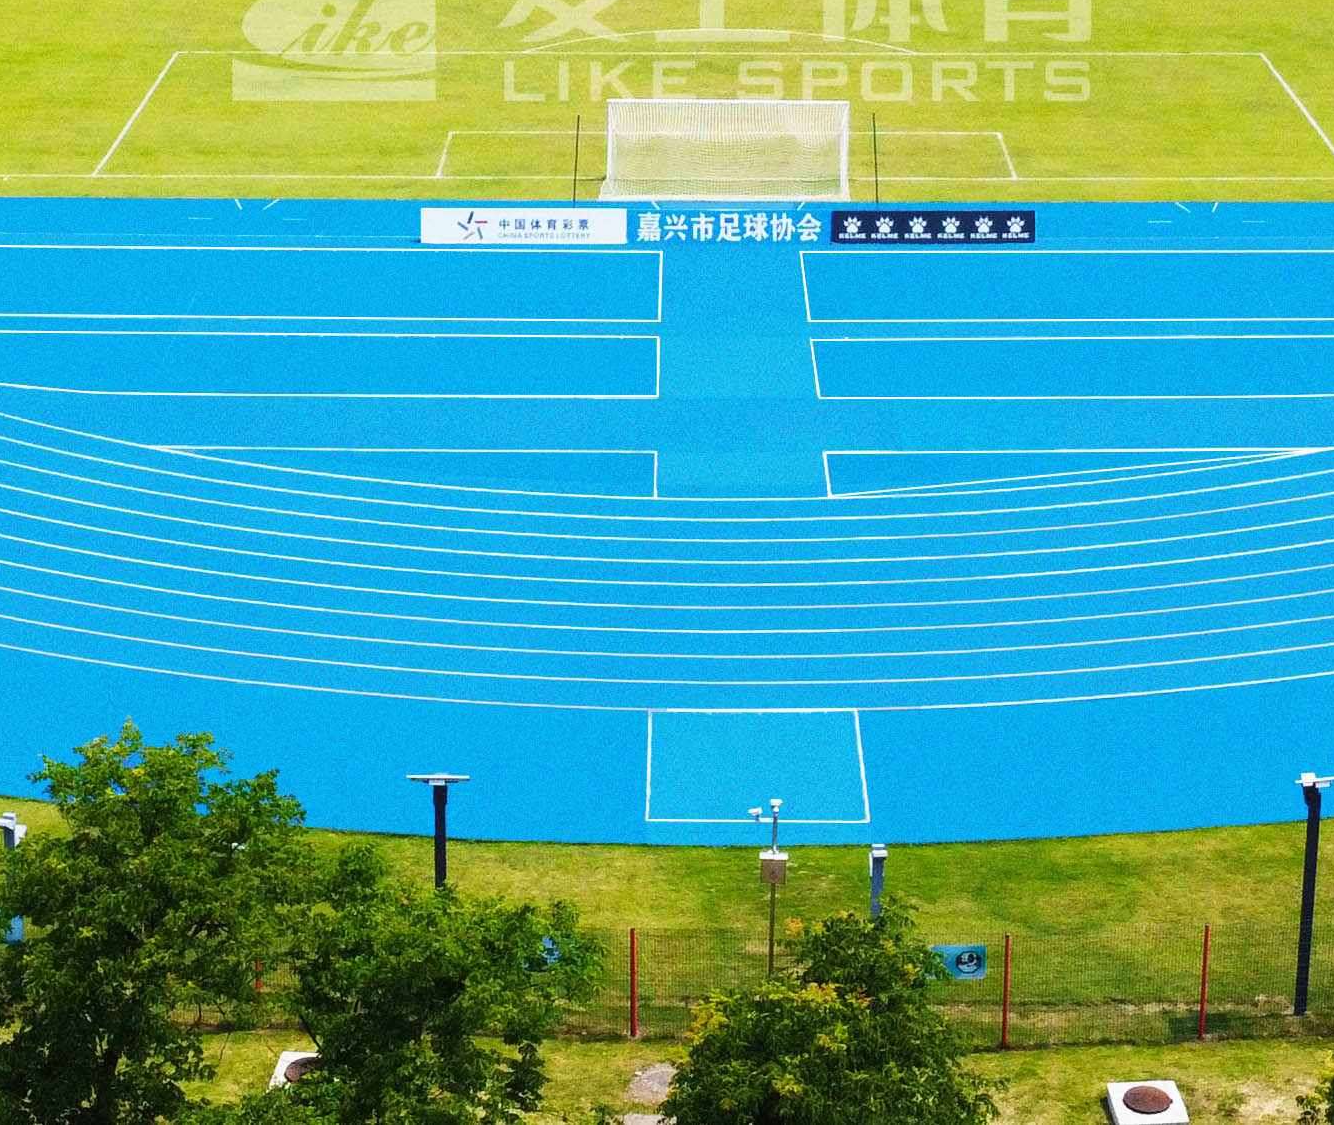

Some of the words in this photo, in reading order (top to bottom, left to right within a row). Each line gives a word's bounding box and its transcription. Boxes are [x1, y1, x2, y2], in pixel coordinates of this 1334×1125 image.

[498, 218, 590, 230] 中国体育彩票
[636, 211, 822, 242] 嘉兴市足球协会
